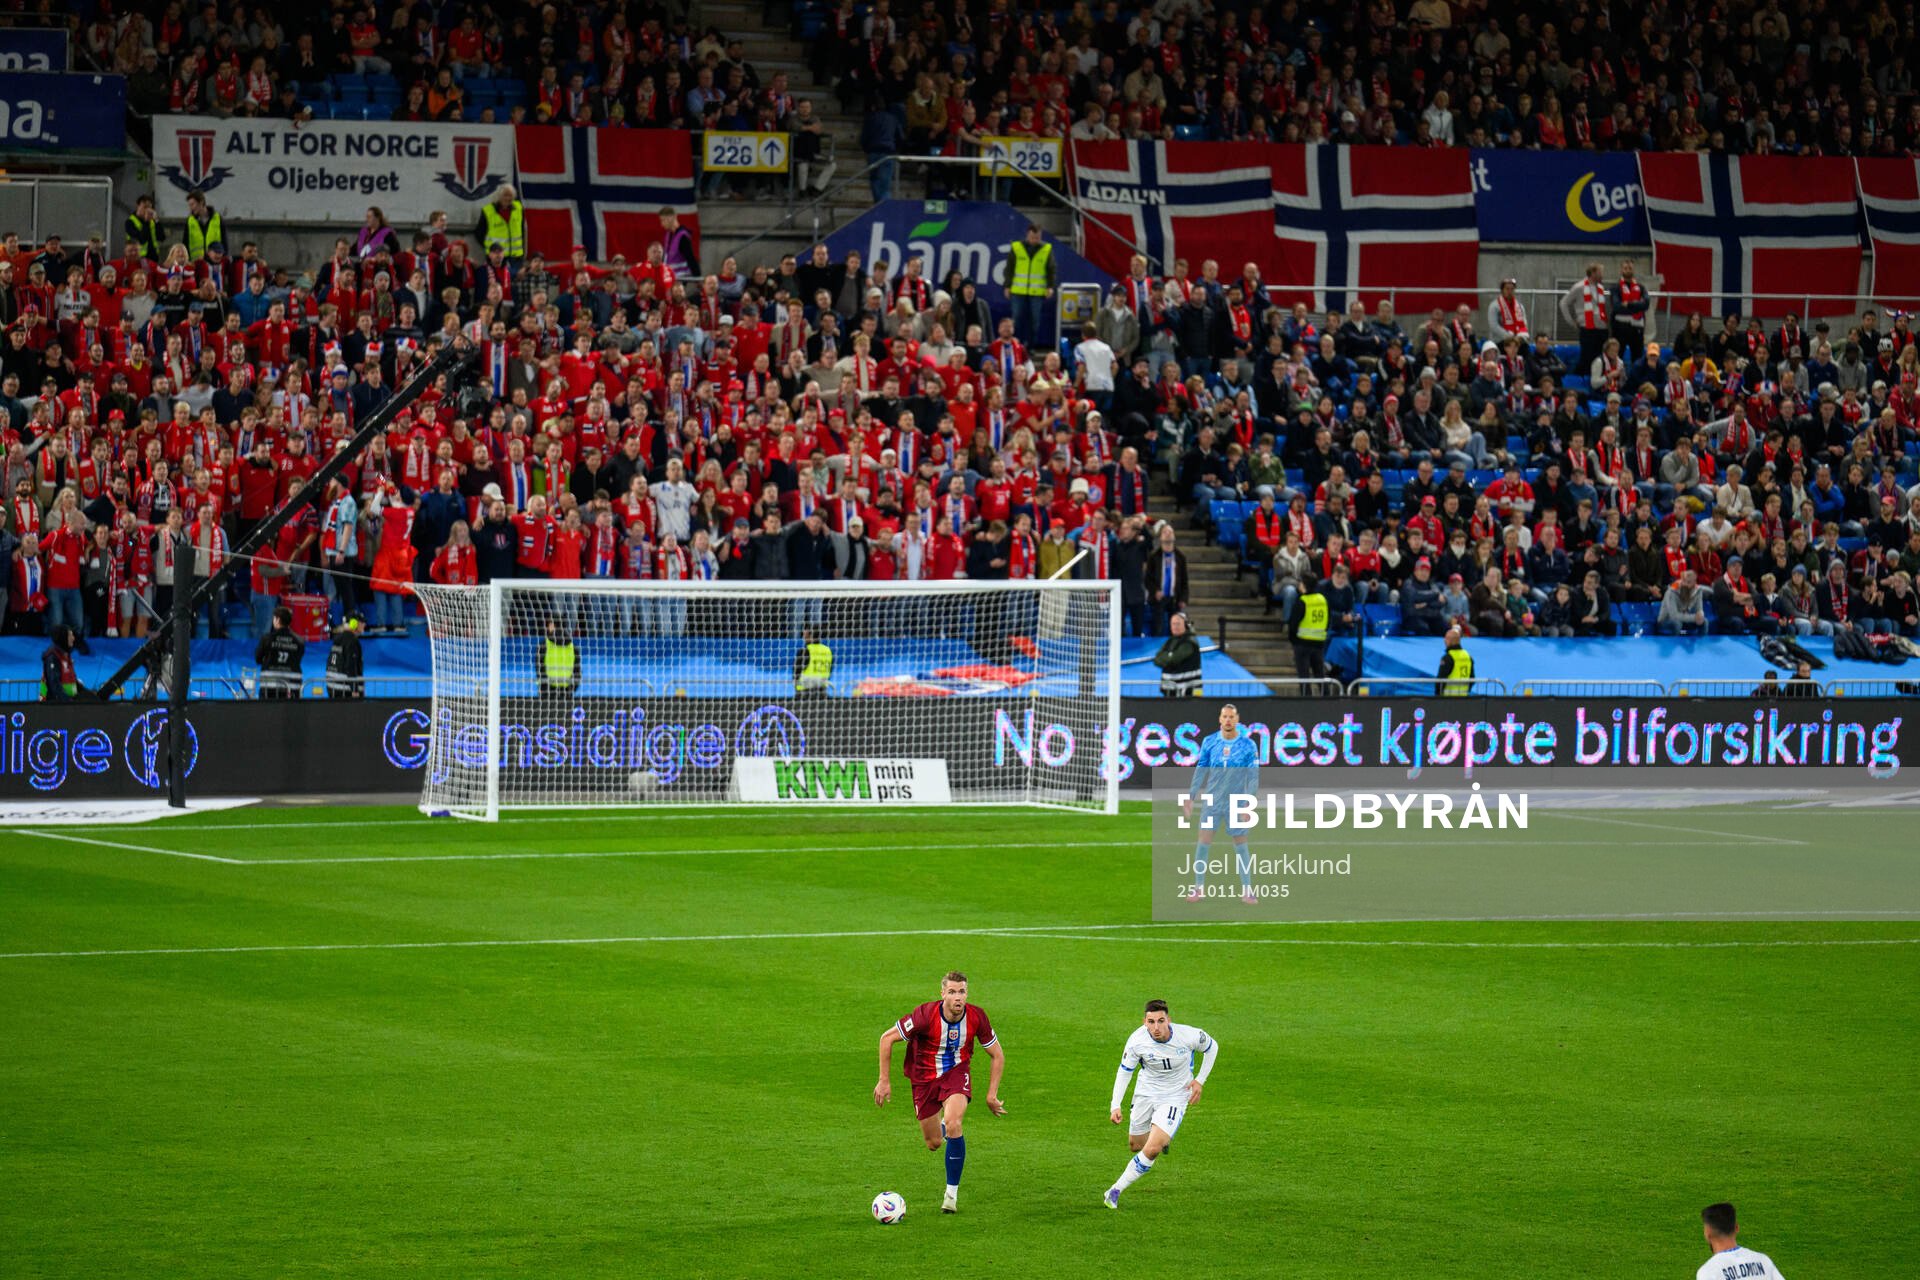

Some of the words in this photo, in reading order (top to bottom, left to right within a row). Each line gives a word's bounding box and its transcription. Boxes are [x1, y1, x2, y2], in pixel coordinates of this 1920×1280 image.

[225, 131, 275, 155] ALT
[283, 132, 338, 157] FOR
[345, 134, 439, 159] NORGE
[713, 145, 752, 166] 226
[1016, 150, 1053, 171] 229
[267, 166, 400, 195] Oljeberget
[0, 711, 113, 790] ige
[382, 707, 726, 785] Gjensidige
[993, 707, 1201, 783] Noges
[1380, 706, 1558, 780] kjøpte
[1574, 706, 1903, 780] bilforsikring
[773, 760, 872, 800] KIWI
[874, 761, 915, 781] mini
[876, 784, 913, 803] pris
[1161, 1057, 1173, 1071] 11
[1167, 1105, 1178, 1121] 11
